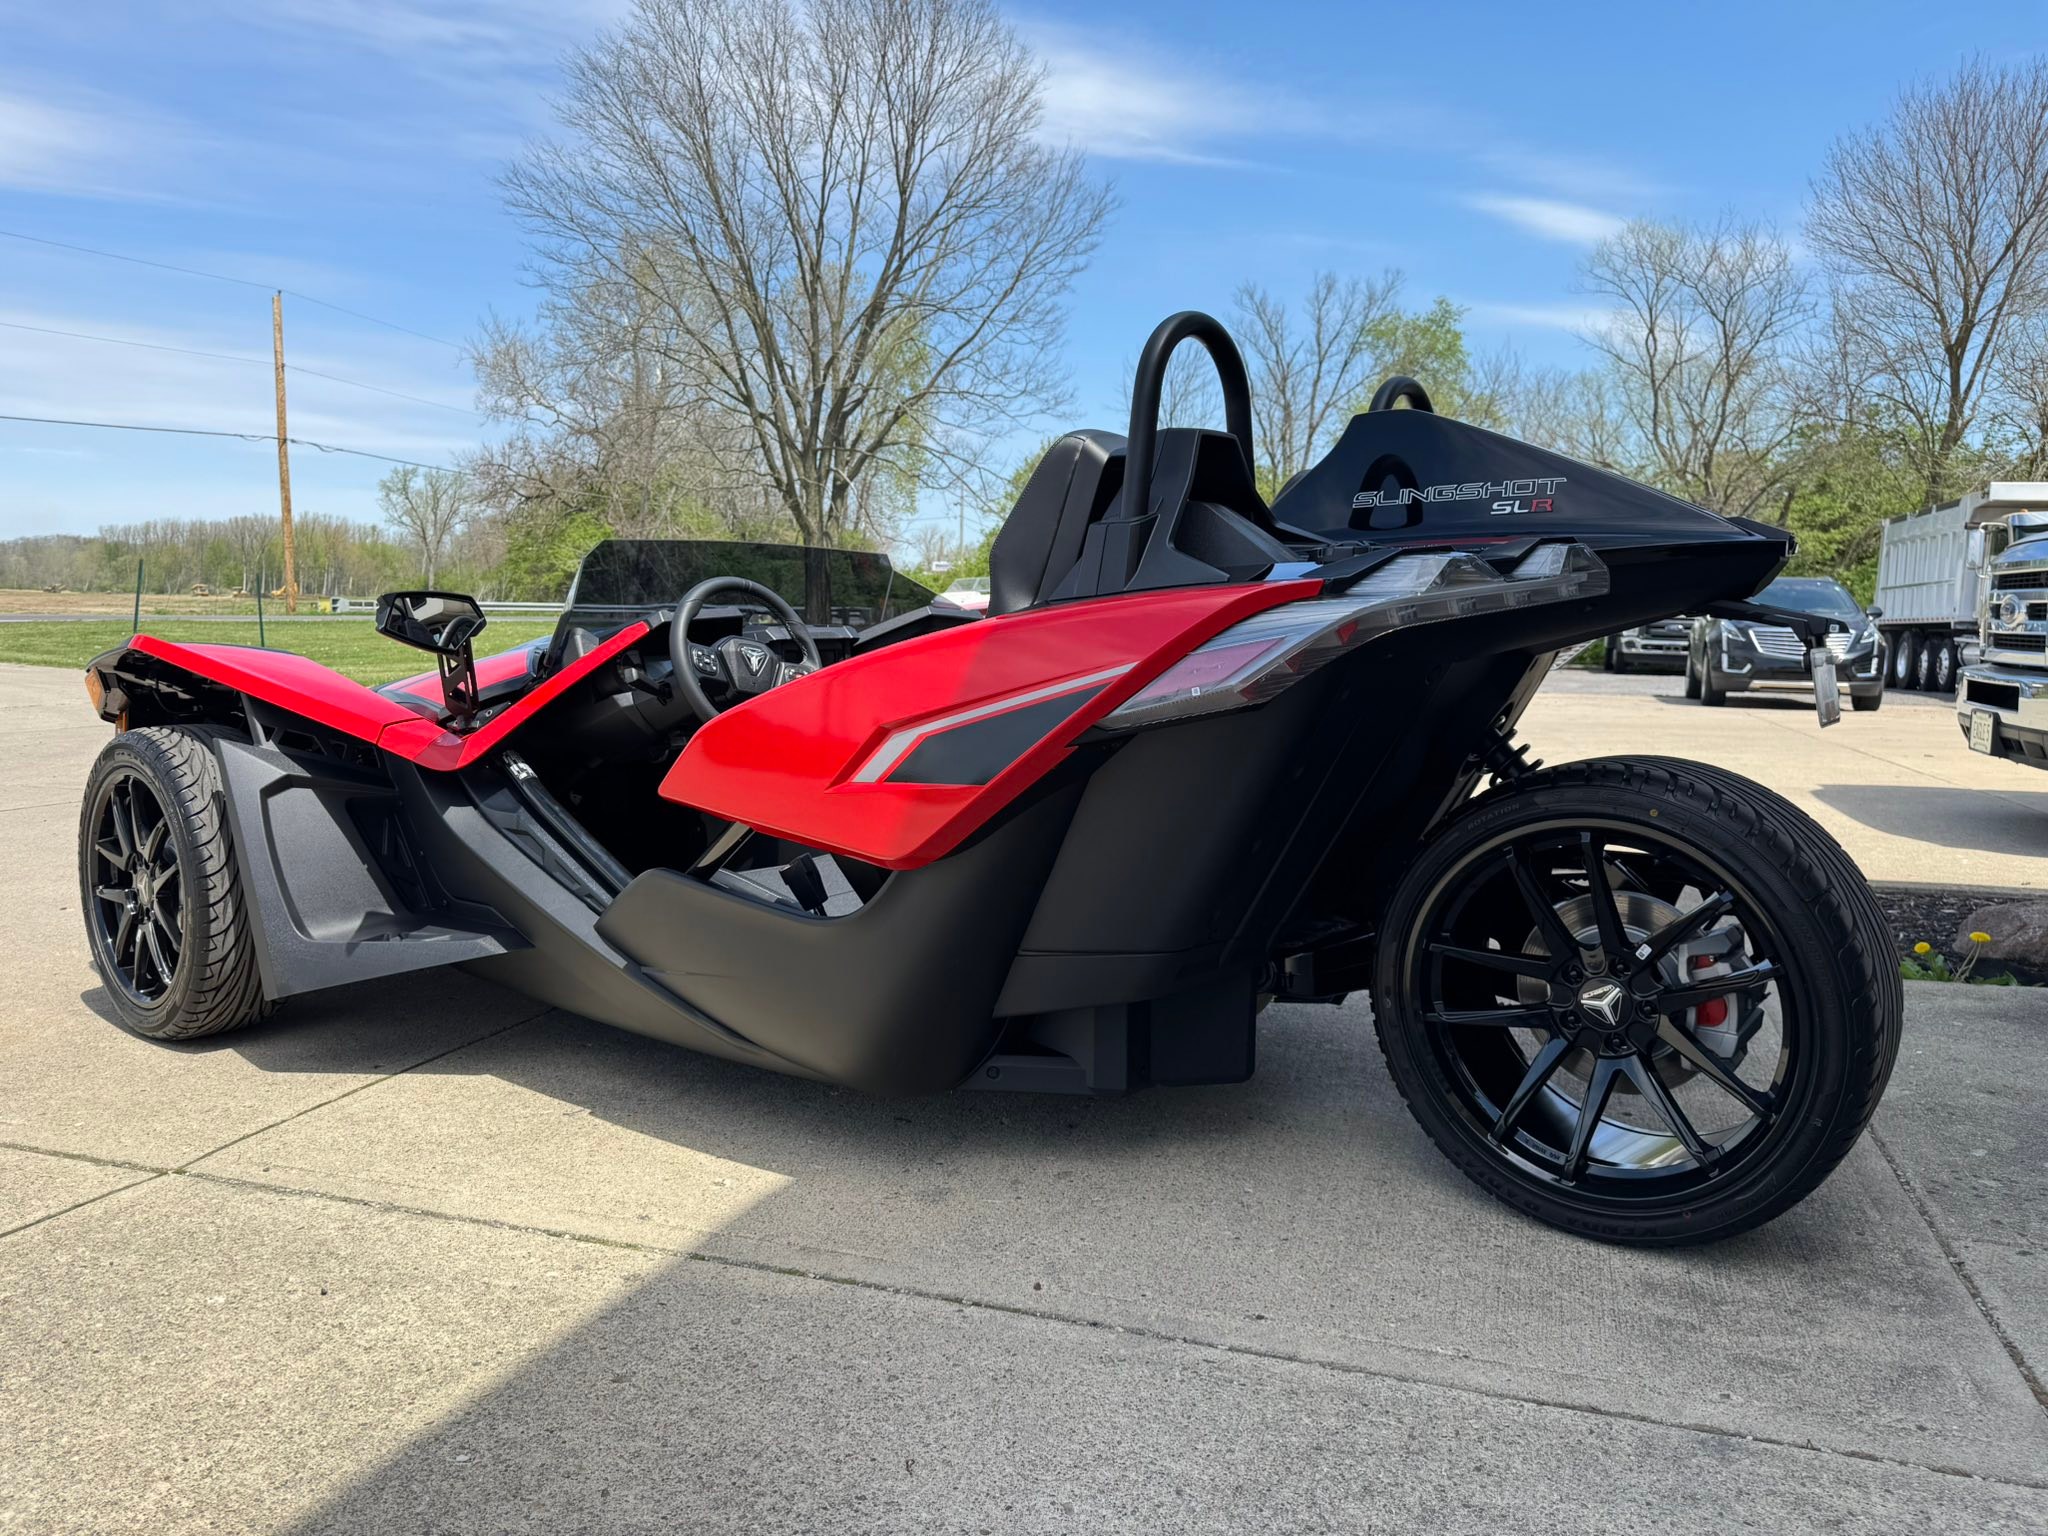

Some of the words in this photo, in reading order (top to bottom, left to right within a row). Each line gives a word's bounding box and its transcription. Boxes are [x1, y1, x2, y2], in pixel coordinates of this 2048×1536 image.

[1352, 477, 1567, 509] SLINGSHOT
[1490, 498, 1553, 515] SLR
[1467, 803, 1520, 831] ROTATION
